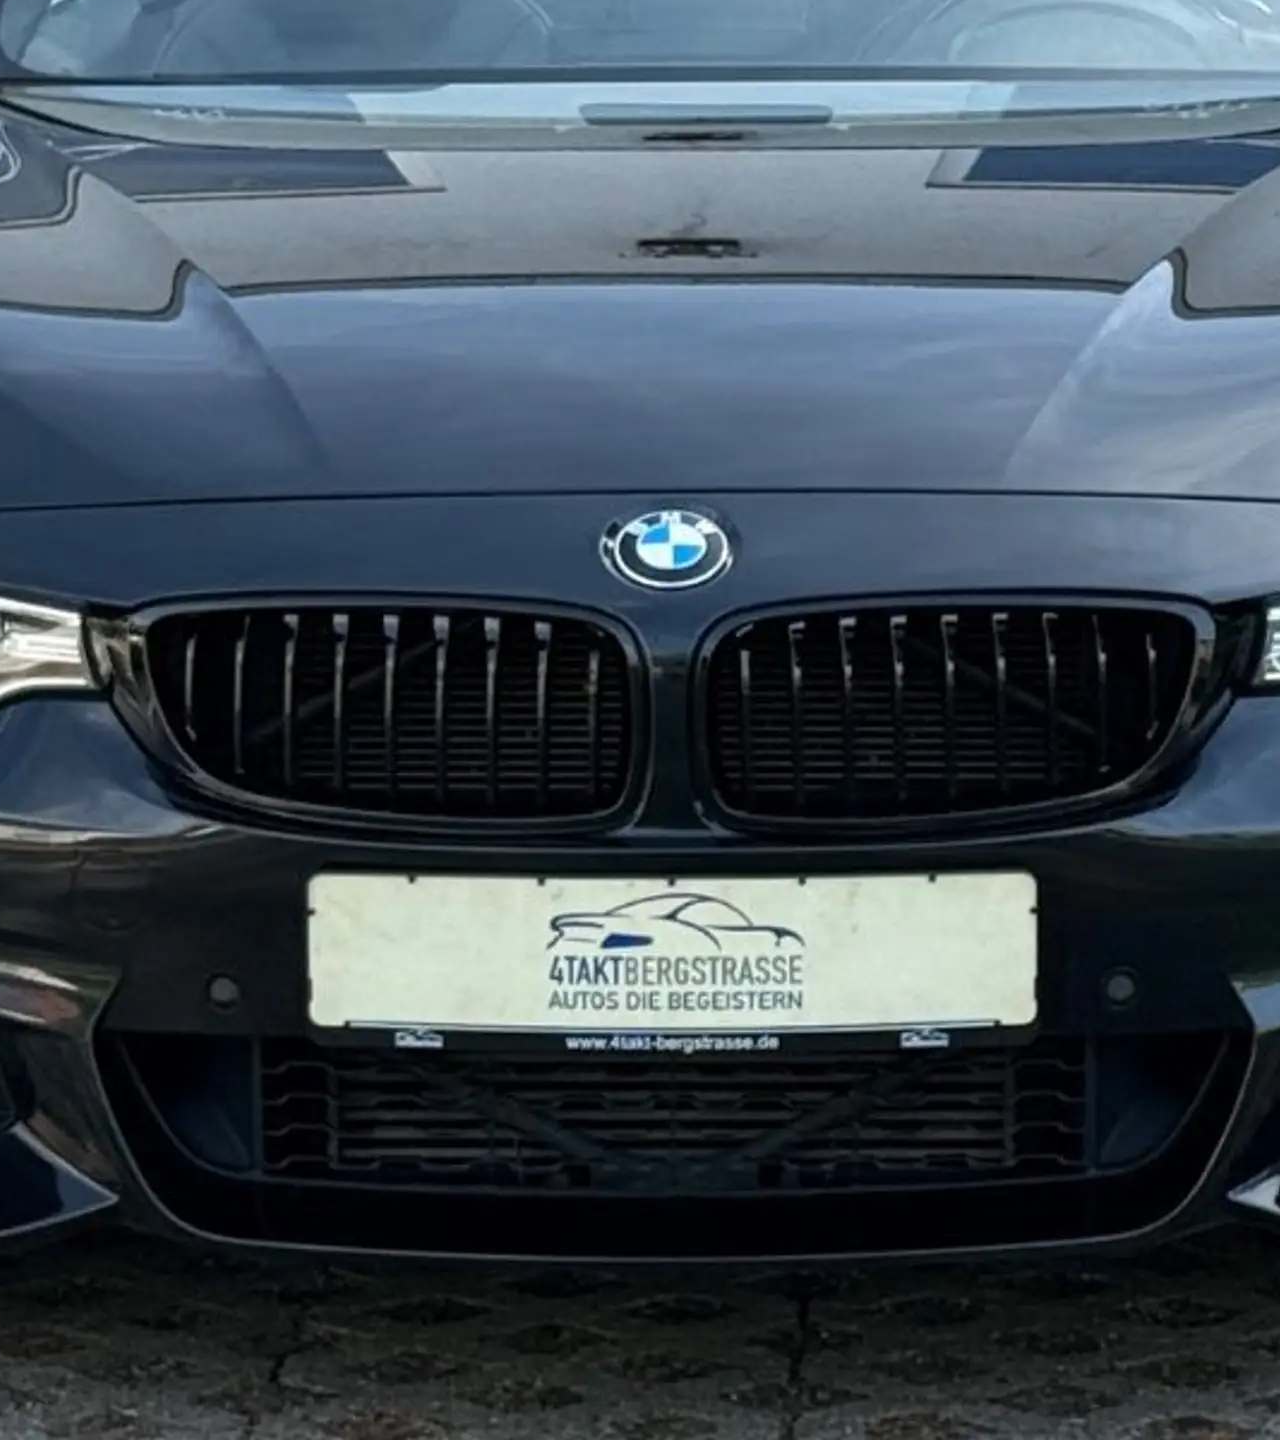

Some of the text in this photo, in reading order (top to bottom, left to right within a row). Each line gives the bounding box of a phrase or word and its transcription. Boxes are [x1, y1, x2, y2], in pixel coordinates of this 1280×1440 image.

[548, 955, 803, 986] 4TAKTBERGSTRASSE
[548, 991, 804, 1010] AUTOS DIE BEGEISTERN
[565, 1035, 781, 1054] www.4takt-bergstrasse.de
